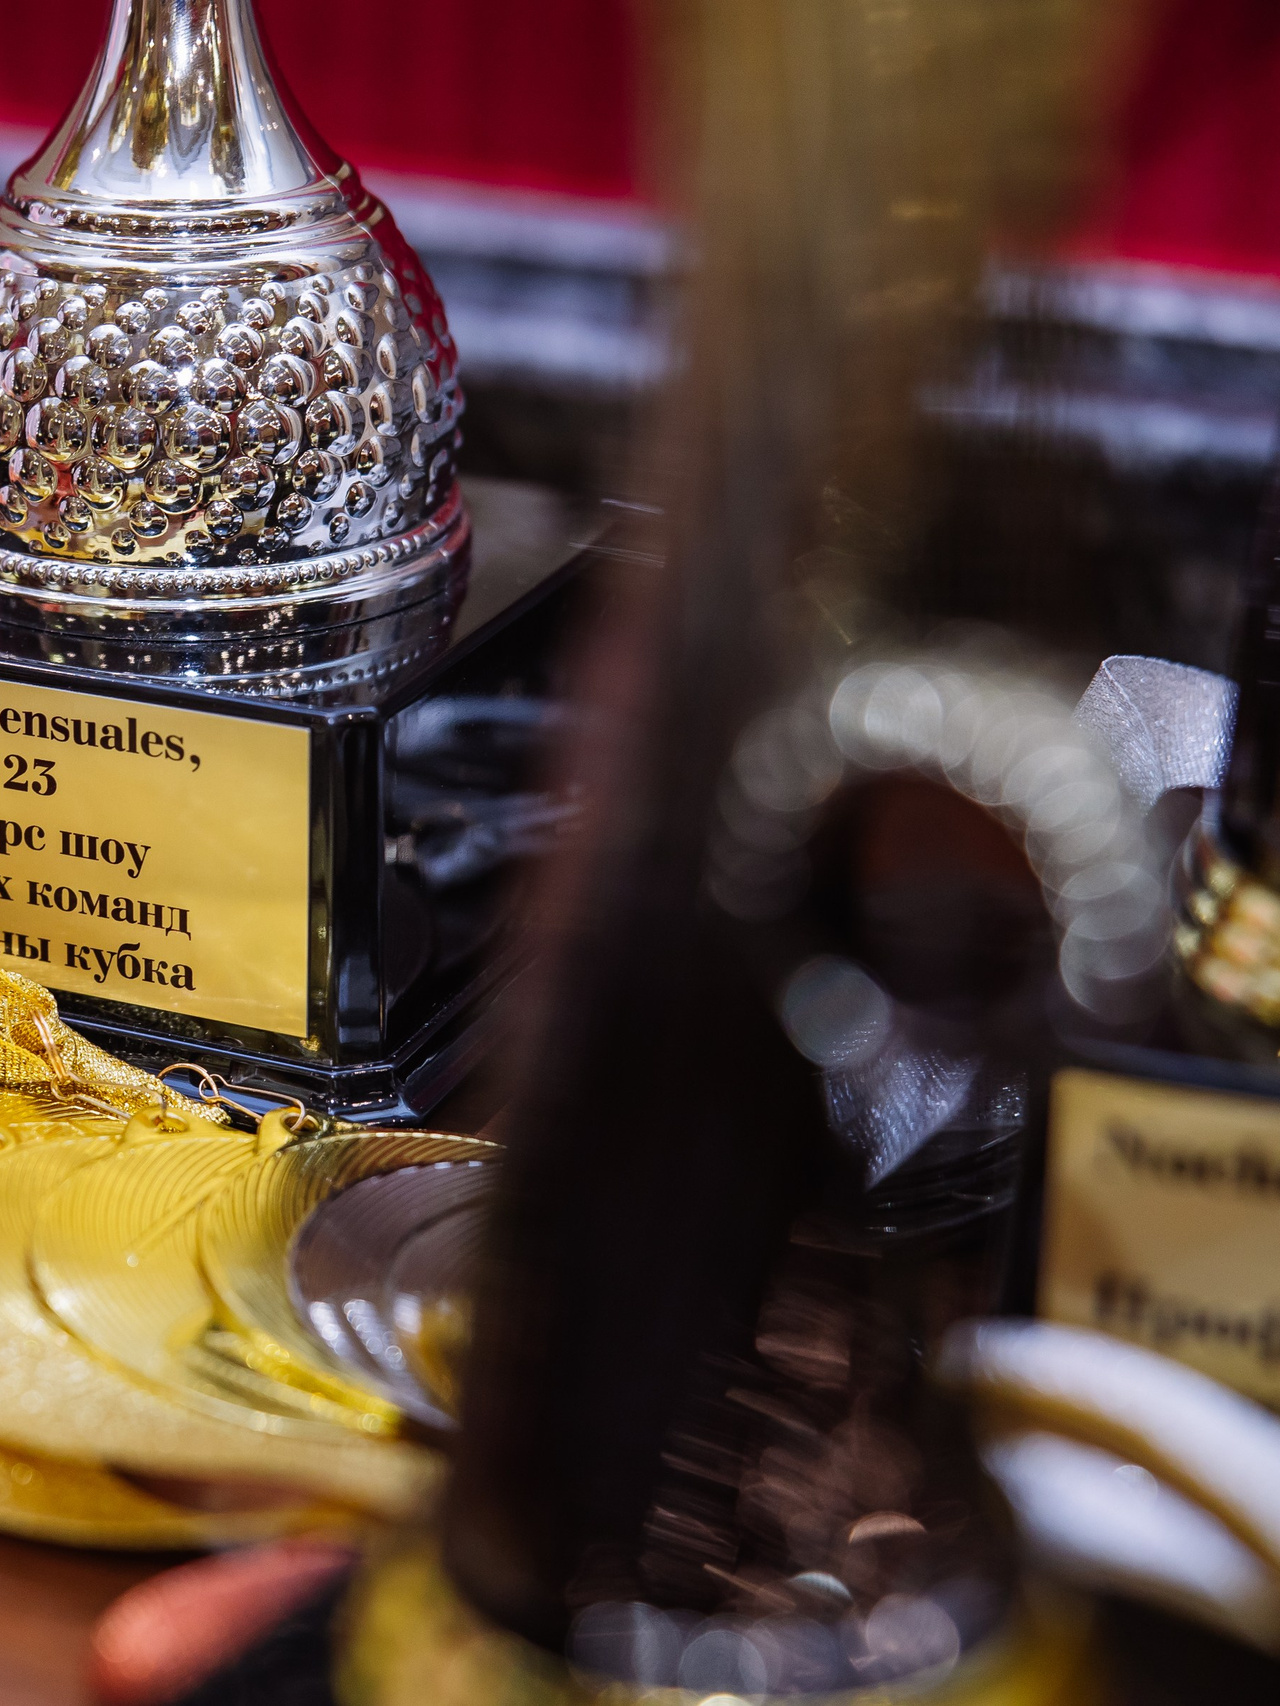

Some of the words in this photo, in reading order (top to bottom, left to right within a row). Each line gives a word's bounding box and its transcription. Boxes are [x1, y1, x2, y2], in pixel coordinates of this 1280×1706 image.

[60, 829, 152, 879] шоу
[27, 880, 192, 941] команд
[65, 942, 197, 991] кубка
